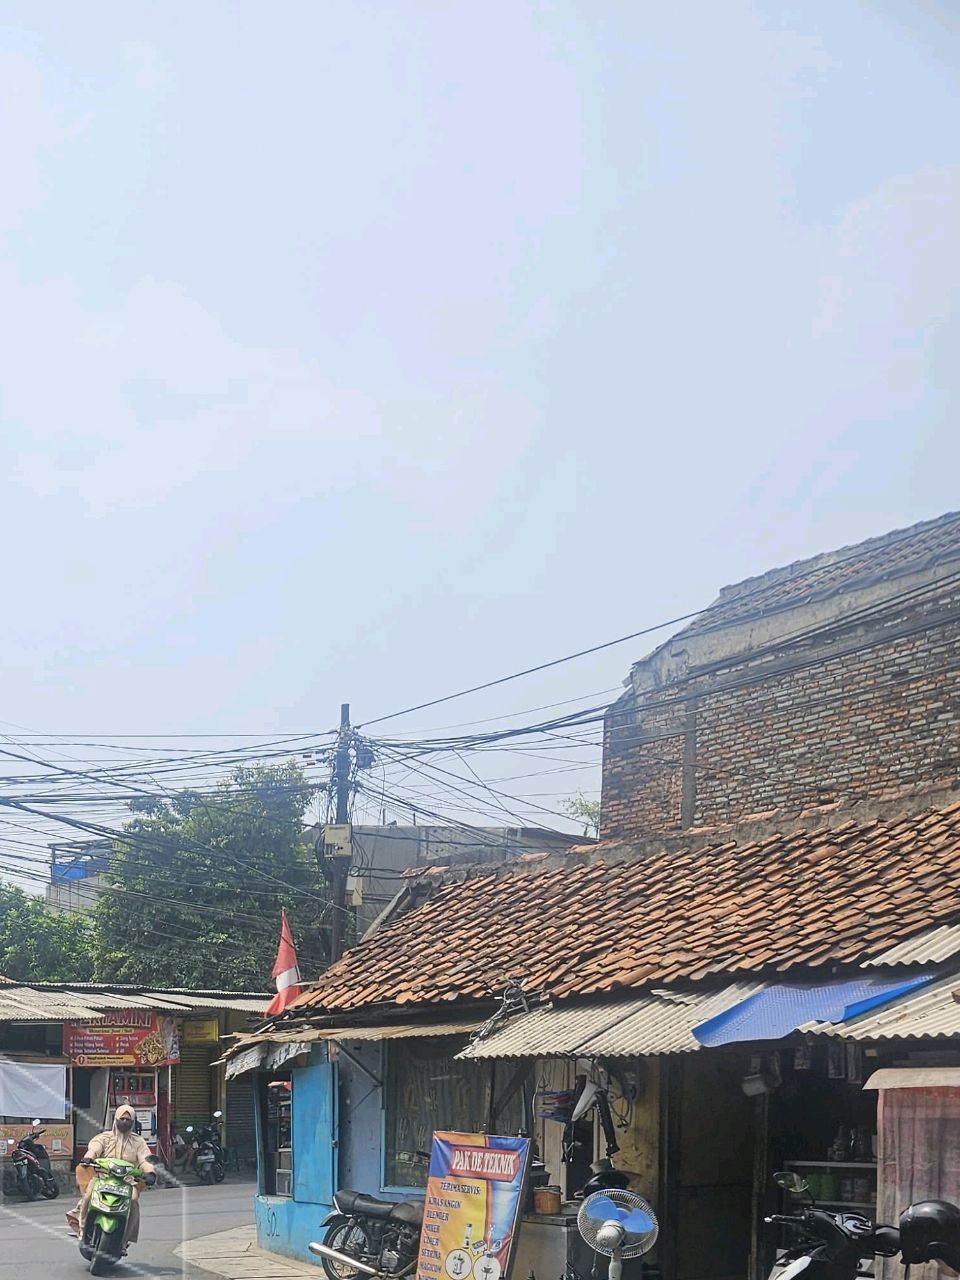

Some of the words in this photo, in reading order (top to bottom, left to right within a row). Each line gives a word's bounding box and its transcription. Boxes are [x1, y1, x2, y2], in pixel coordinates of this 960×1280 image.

[71, 1010, 153, 1027] RTAMINI
[452, 1150, 470, 1170] PAK
[471, 1151, 484, 1172] DE
[483, 1152, 517, 1175] TEKNIK
